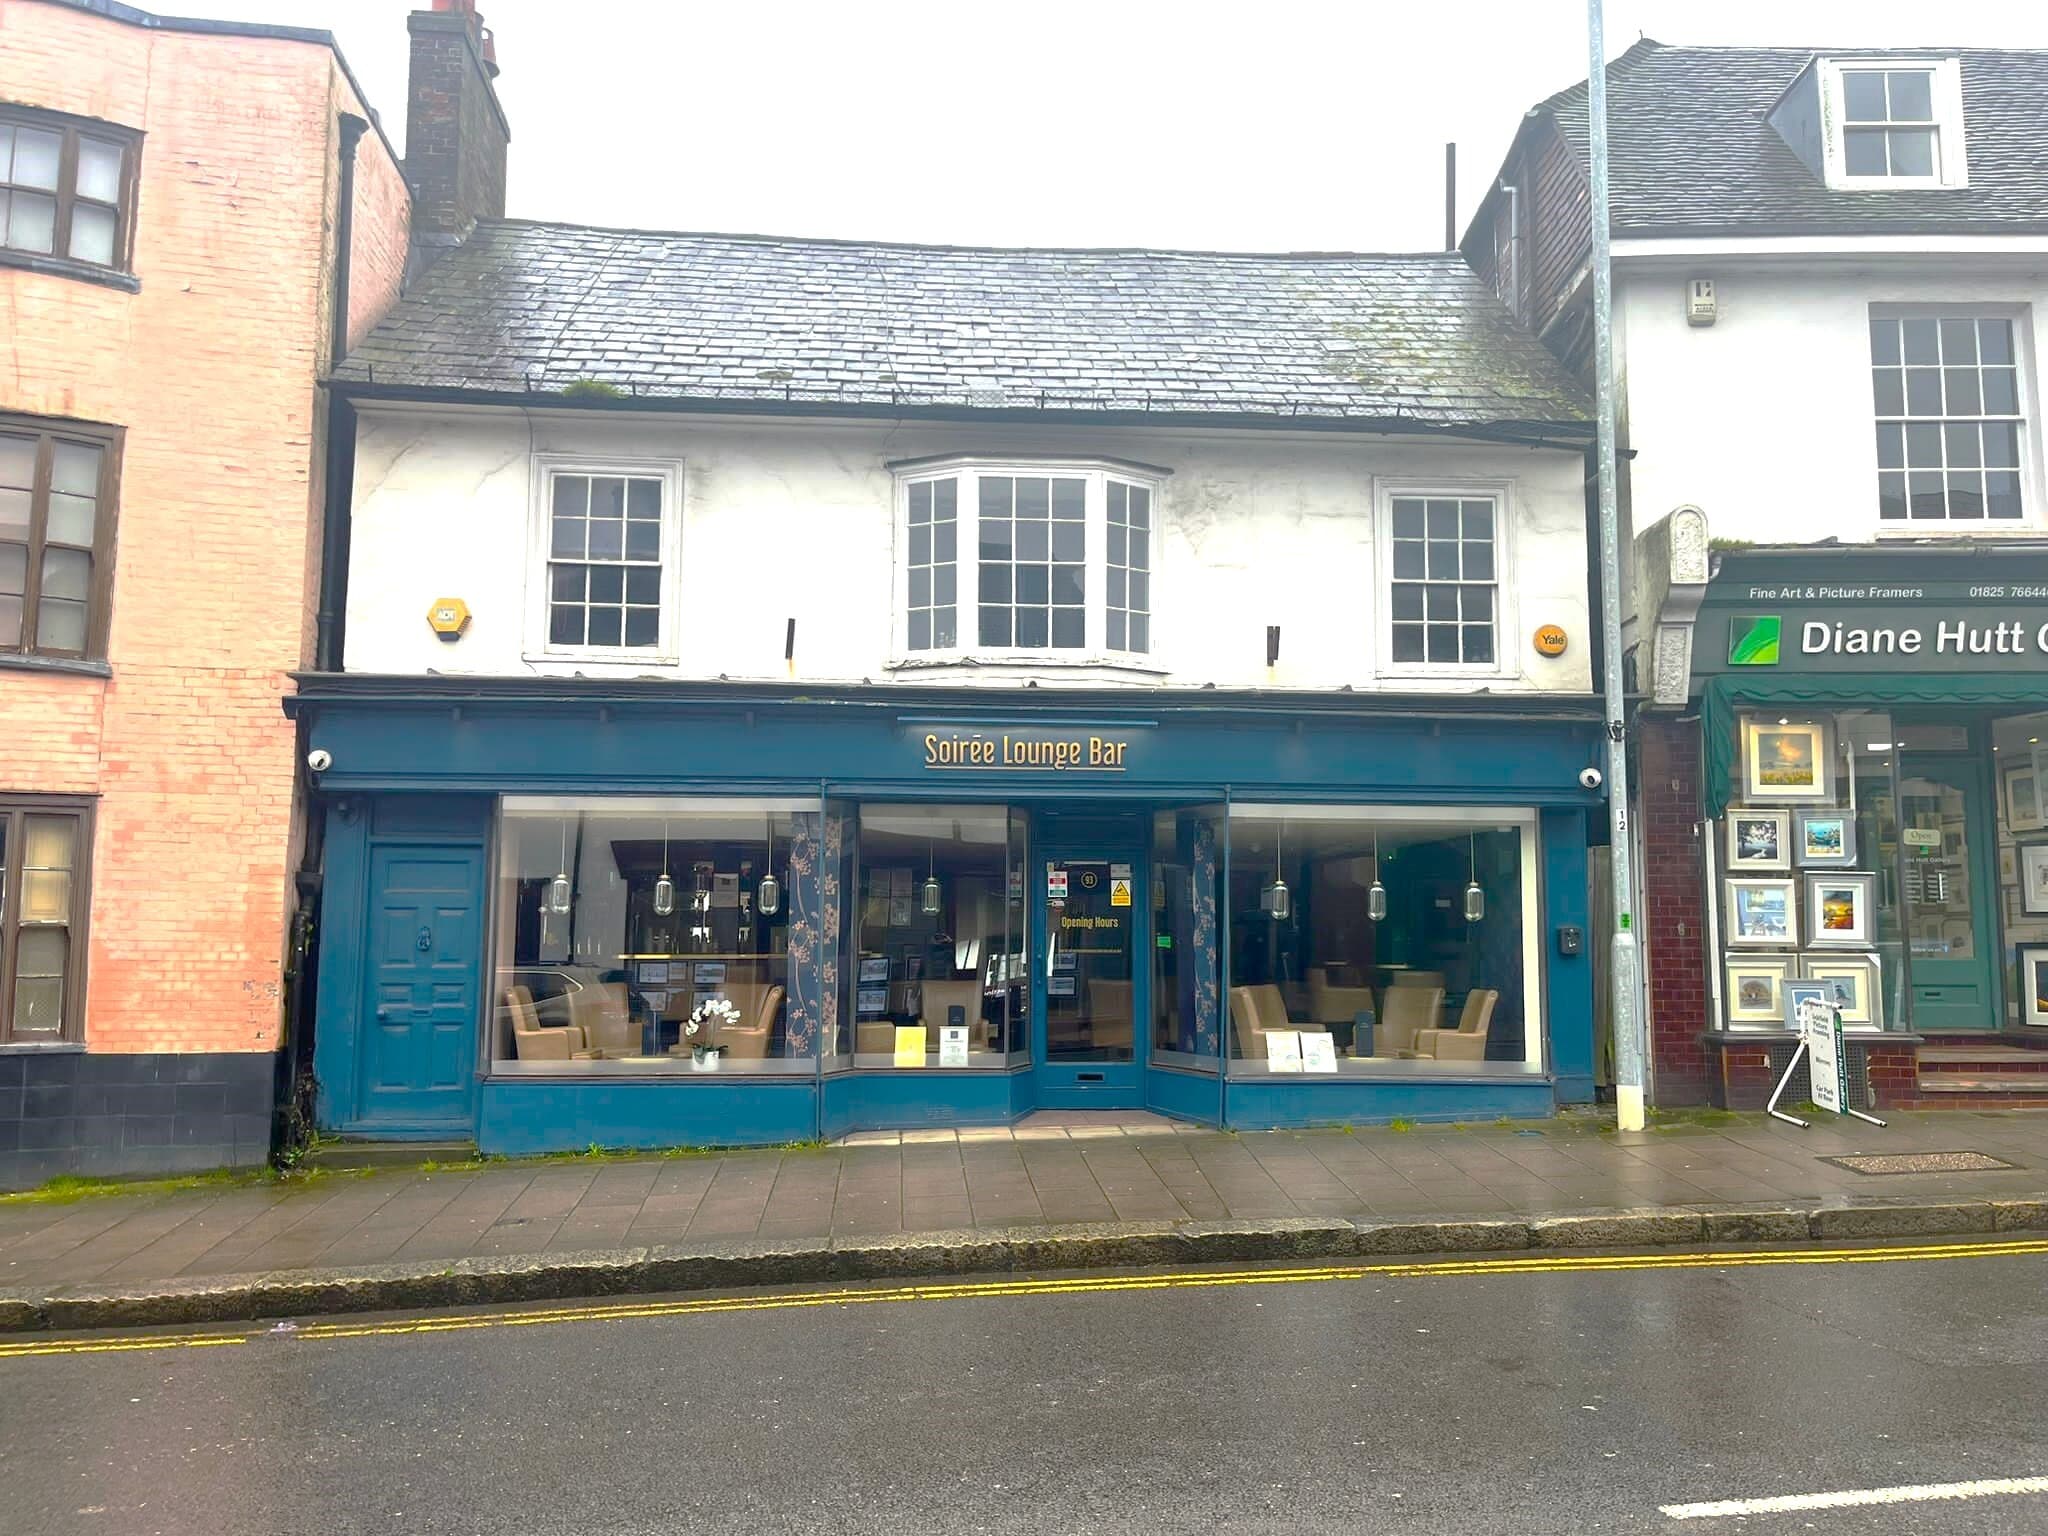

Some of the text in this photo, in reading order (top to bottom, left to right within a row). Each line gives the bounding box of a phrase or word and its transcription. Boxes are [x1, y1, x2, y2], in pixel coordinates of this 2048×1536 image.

[1749, 586, 1923, 599] Fine Art & Picture Framers
[1969, 586, 2048, 598] 01825 76644
[1542, 634, 1565, 645] Yale
[1802, 621, 1922, 654] Diane
[1936, 620, 2025, 654] Hutt
[1003, 735, 1081, 770] Lounge
[1089, 736, 1128, 765] Bar
[1061, 916, 1119, 929] Opening Hours
